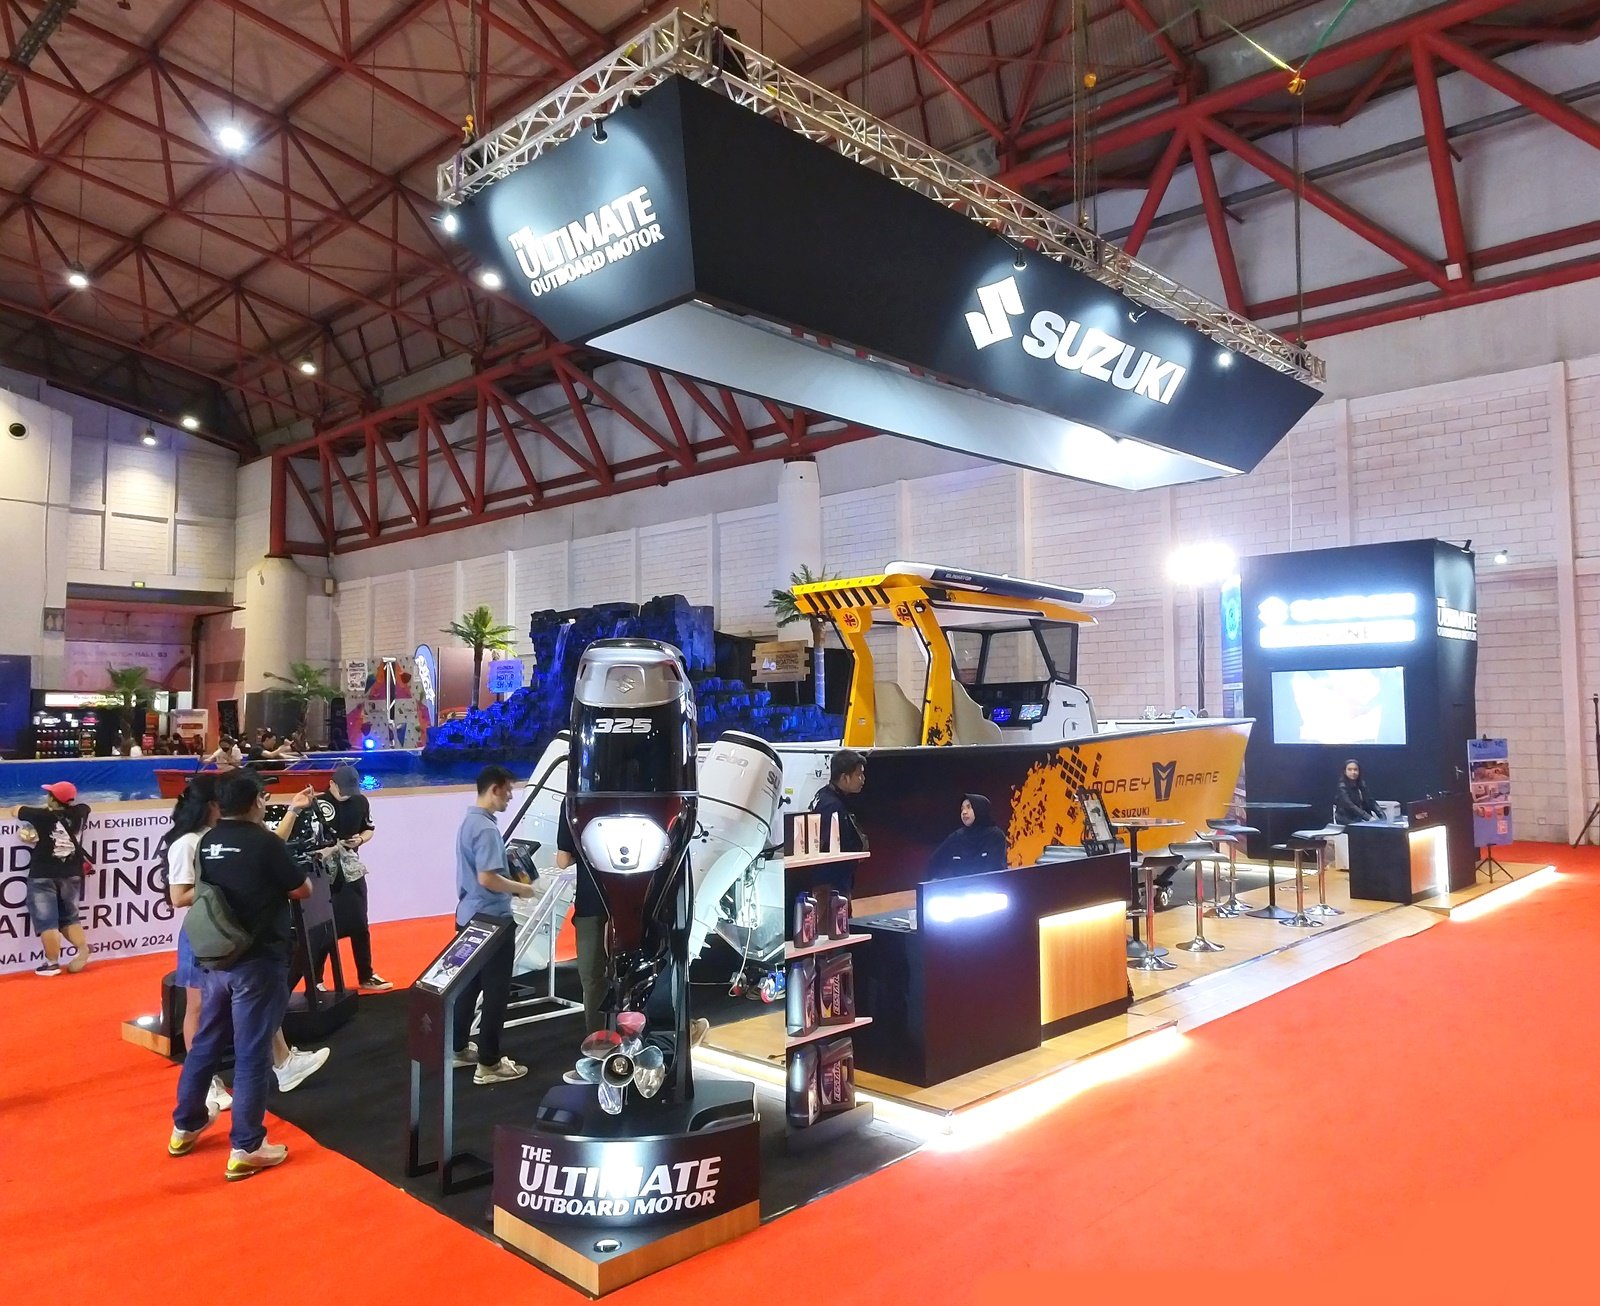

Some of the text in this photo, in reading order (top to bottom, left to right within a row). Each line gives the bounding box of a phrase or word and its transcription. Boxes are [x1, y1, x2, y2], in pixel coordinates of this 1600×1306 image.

[515, 185, 657, 279] ULTIMATE
[530, 223, 665, 297] OUTBOARD MOTOR
[1021, 310, 1187, 405] SUZUKI
[594, 718, 652, 734] 325
[1091, 777, 1151, 795] MOREY
[1121, 807, 1150, 818] SUZUKI
[141, 934, 173, 947] 2024
[521, 1144, 552, 1163] THE
[519, 1156, 722, 1199] ULTIMATE
[516, 1189, 716, 1217] OUTBOARD MOTOR
